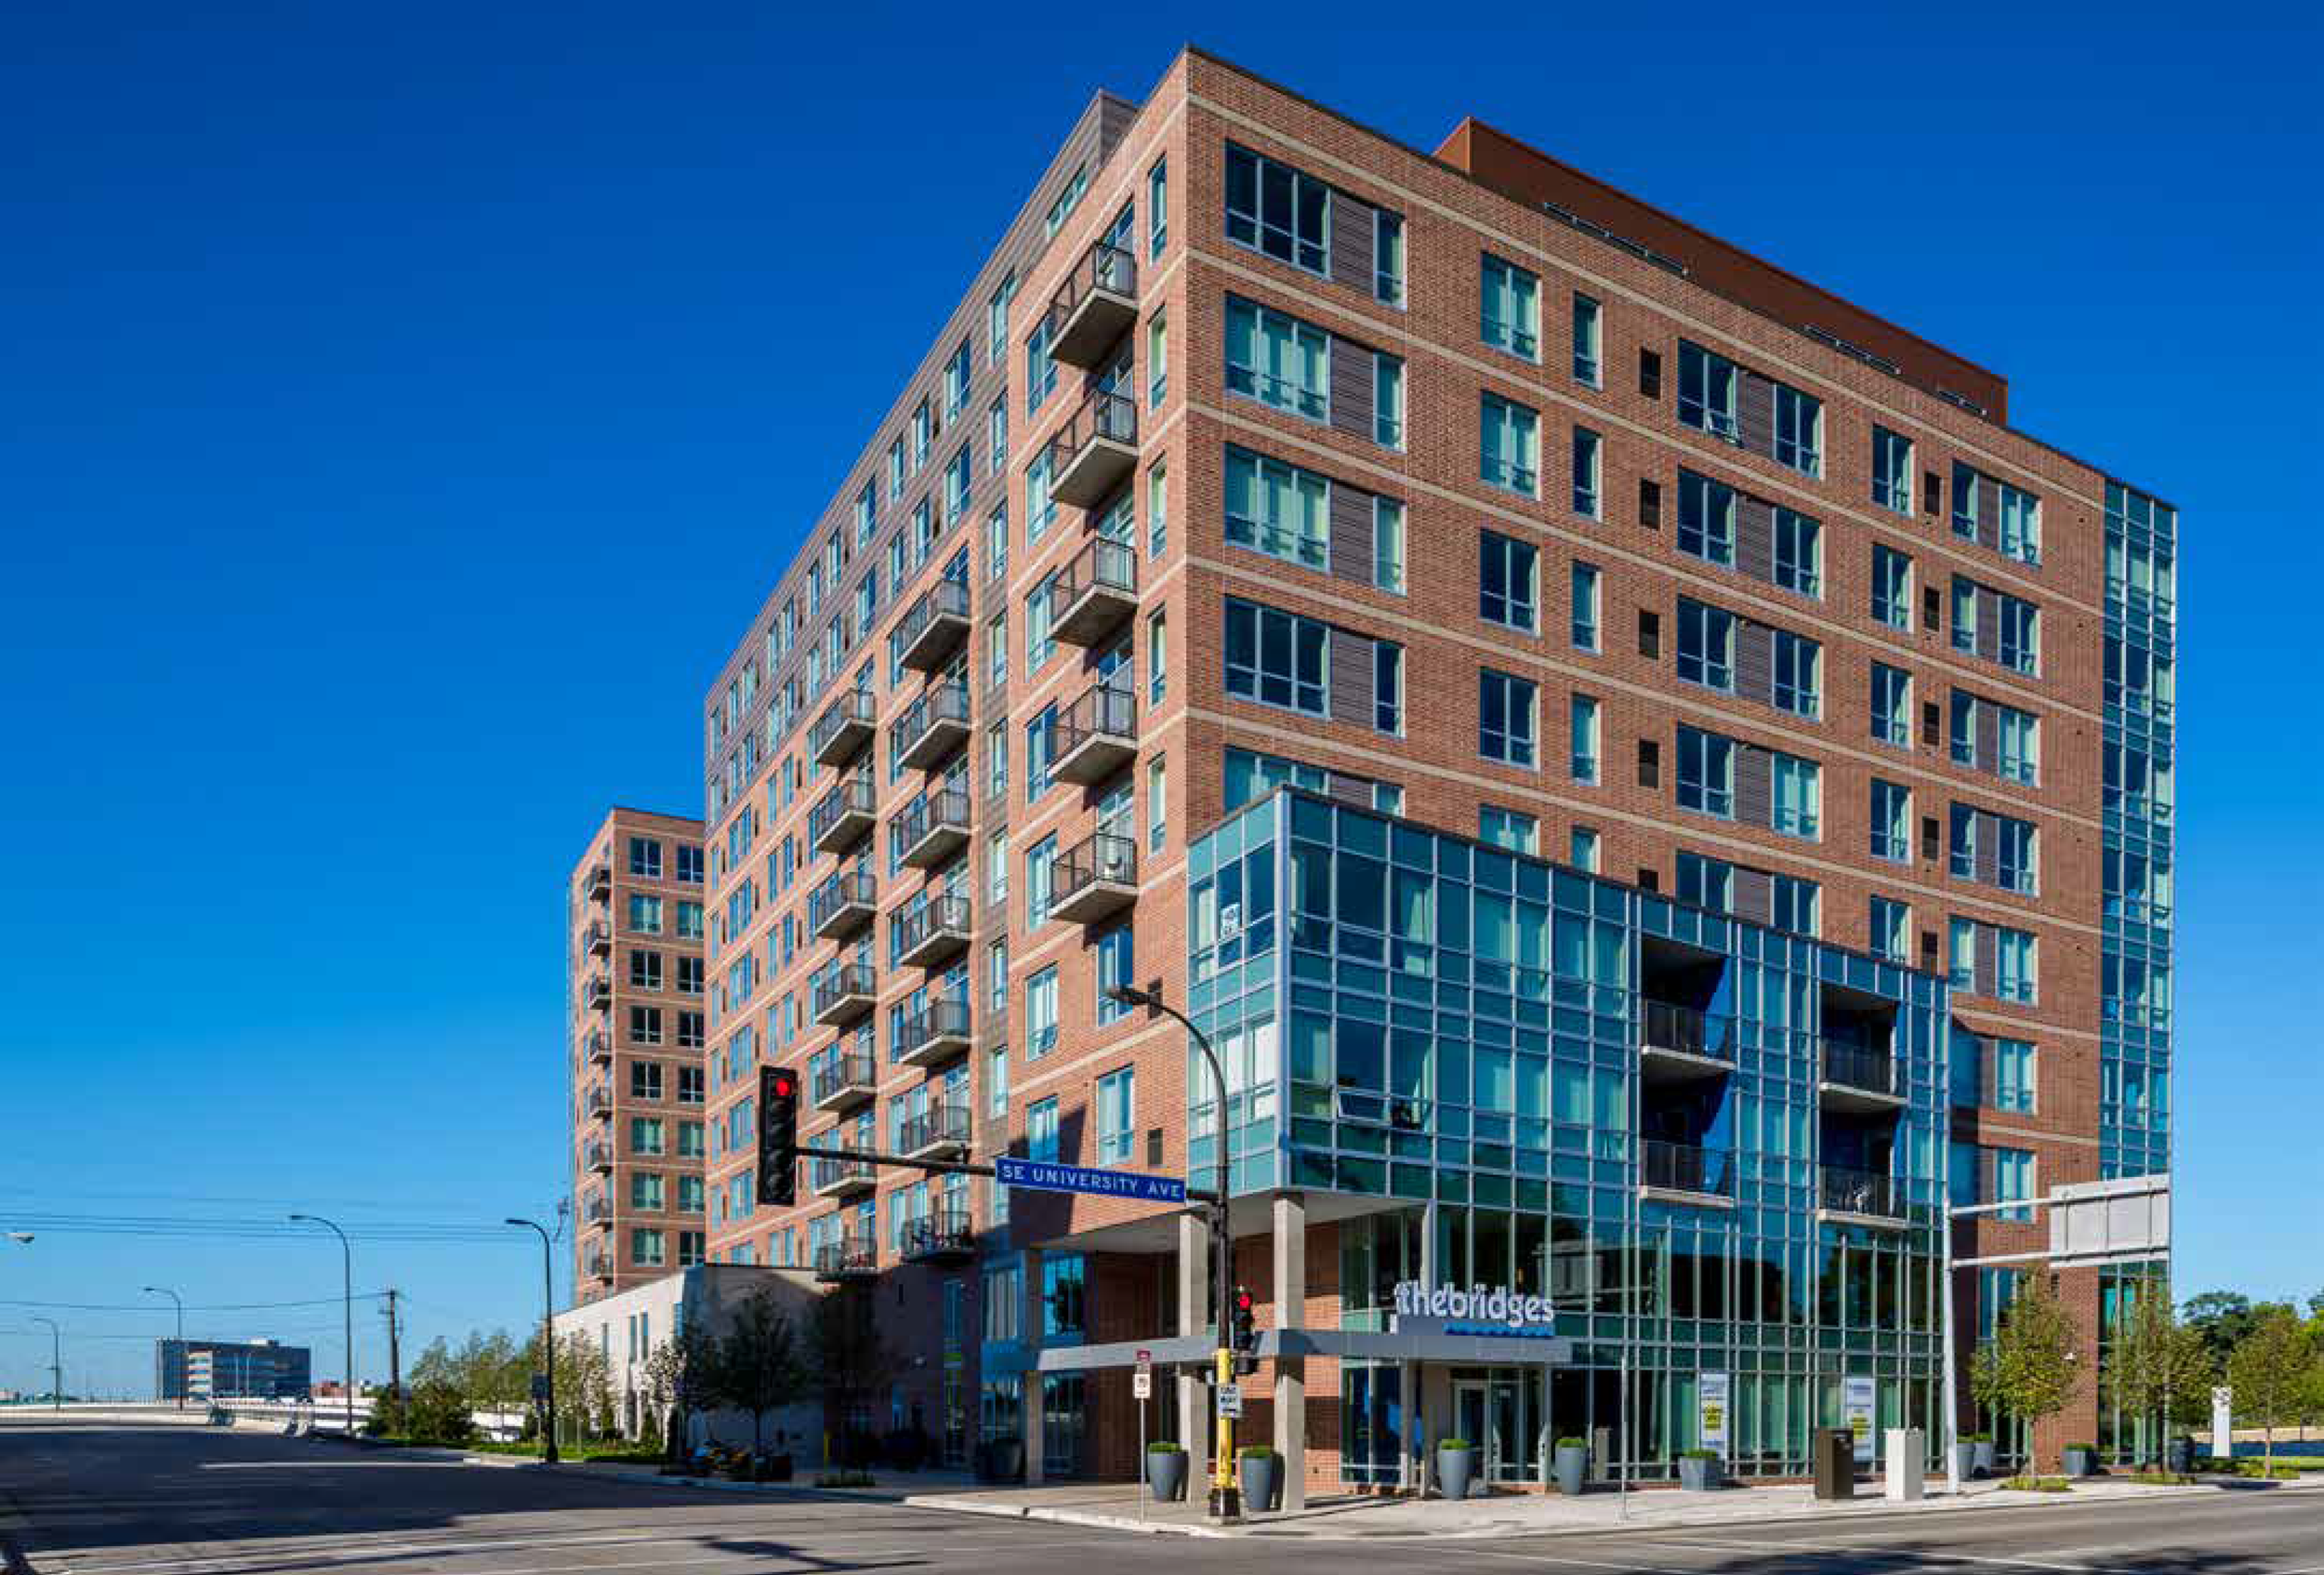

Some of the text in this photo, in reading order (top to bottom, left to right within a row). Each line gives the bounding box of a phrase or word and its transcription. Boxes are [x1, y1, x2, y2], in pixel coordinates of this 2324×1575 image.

[1002, 1165, 1182, 1197] SE UNIVERSITY AVE
[1393, 1280, 1554, 1328] thebridges
